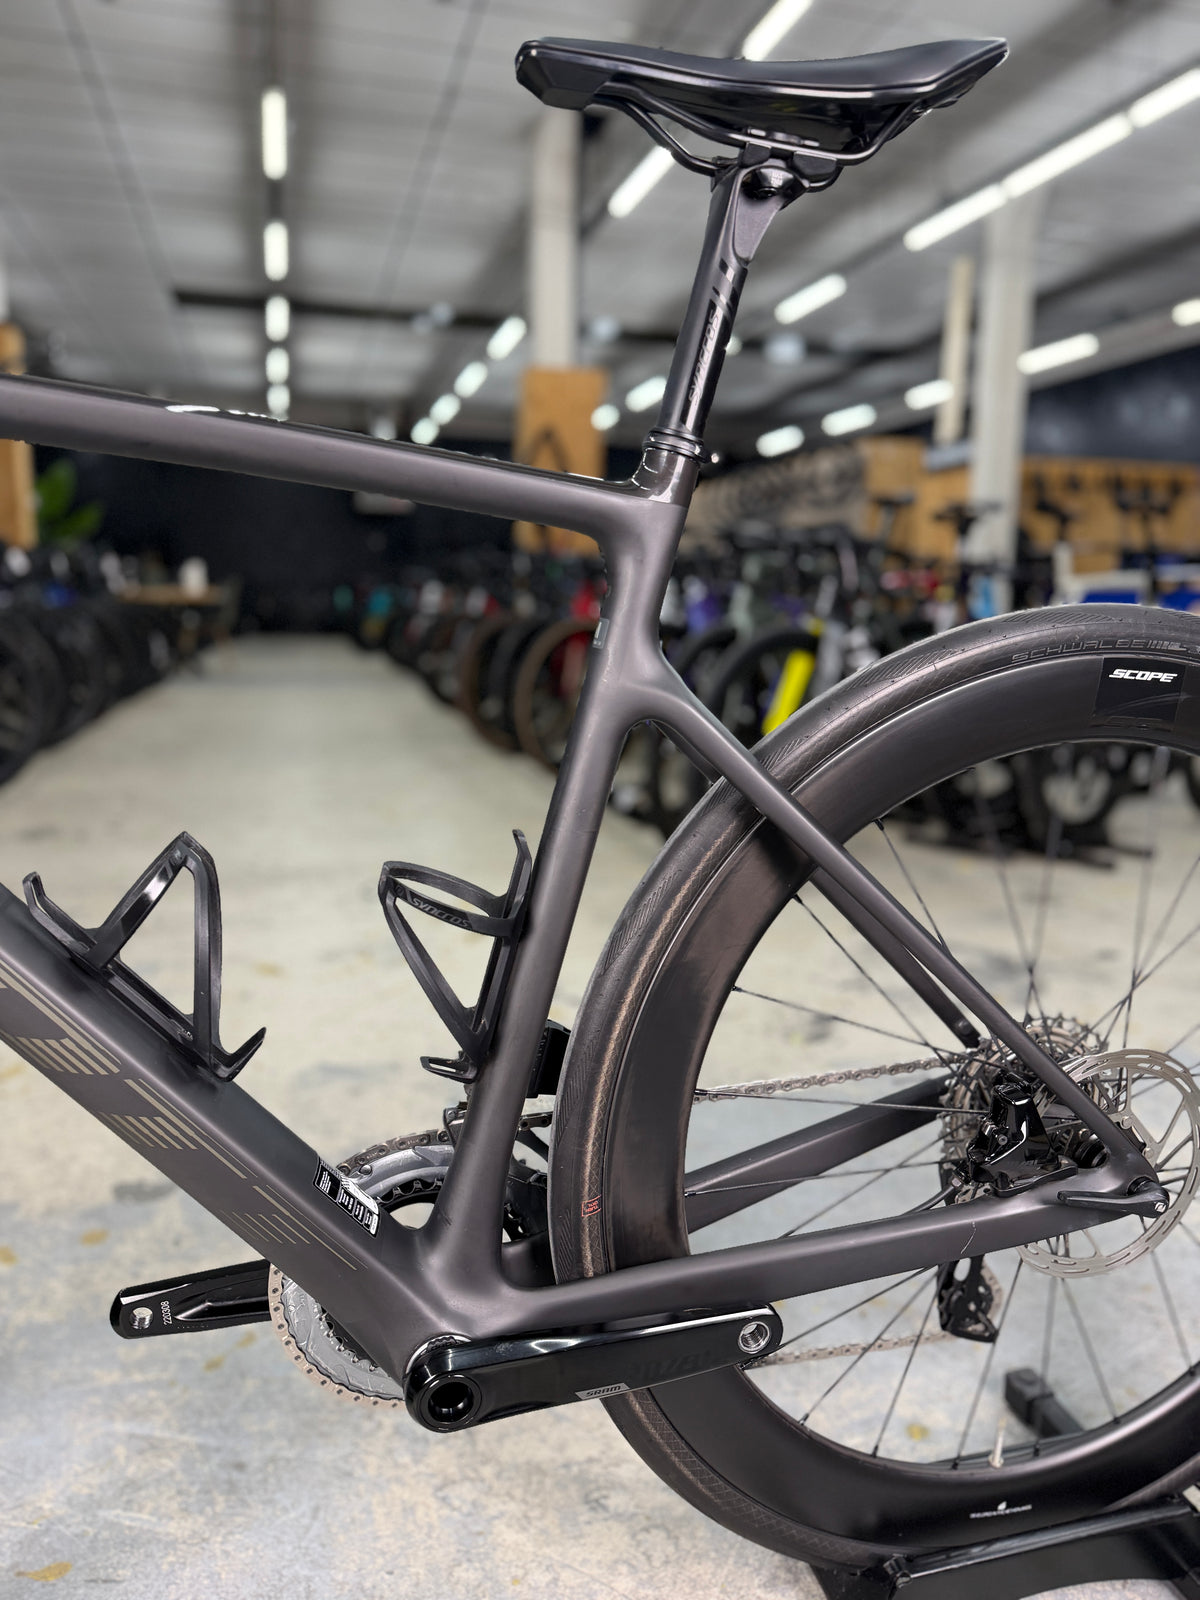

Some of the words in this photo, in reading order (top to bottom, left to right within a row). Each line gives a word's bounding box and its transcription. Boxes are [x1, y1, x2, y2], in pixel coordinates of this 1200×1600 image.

[1011, 639, 1147, 663] SCHWALBE
[1108, 668, 1178, 683] SCOPE
[160, 1300, 173, 1326] 220308
[586, 1385, 621, 1397] SRAM
